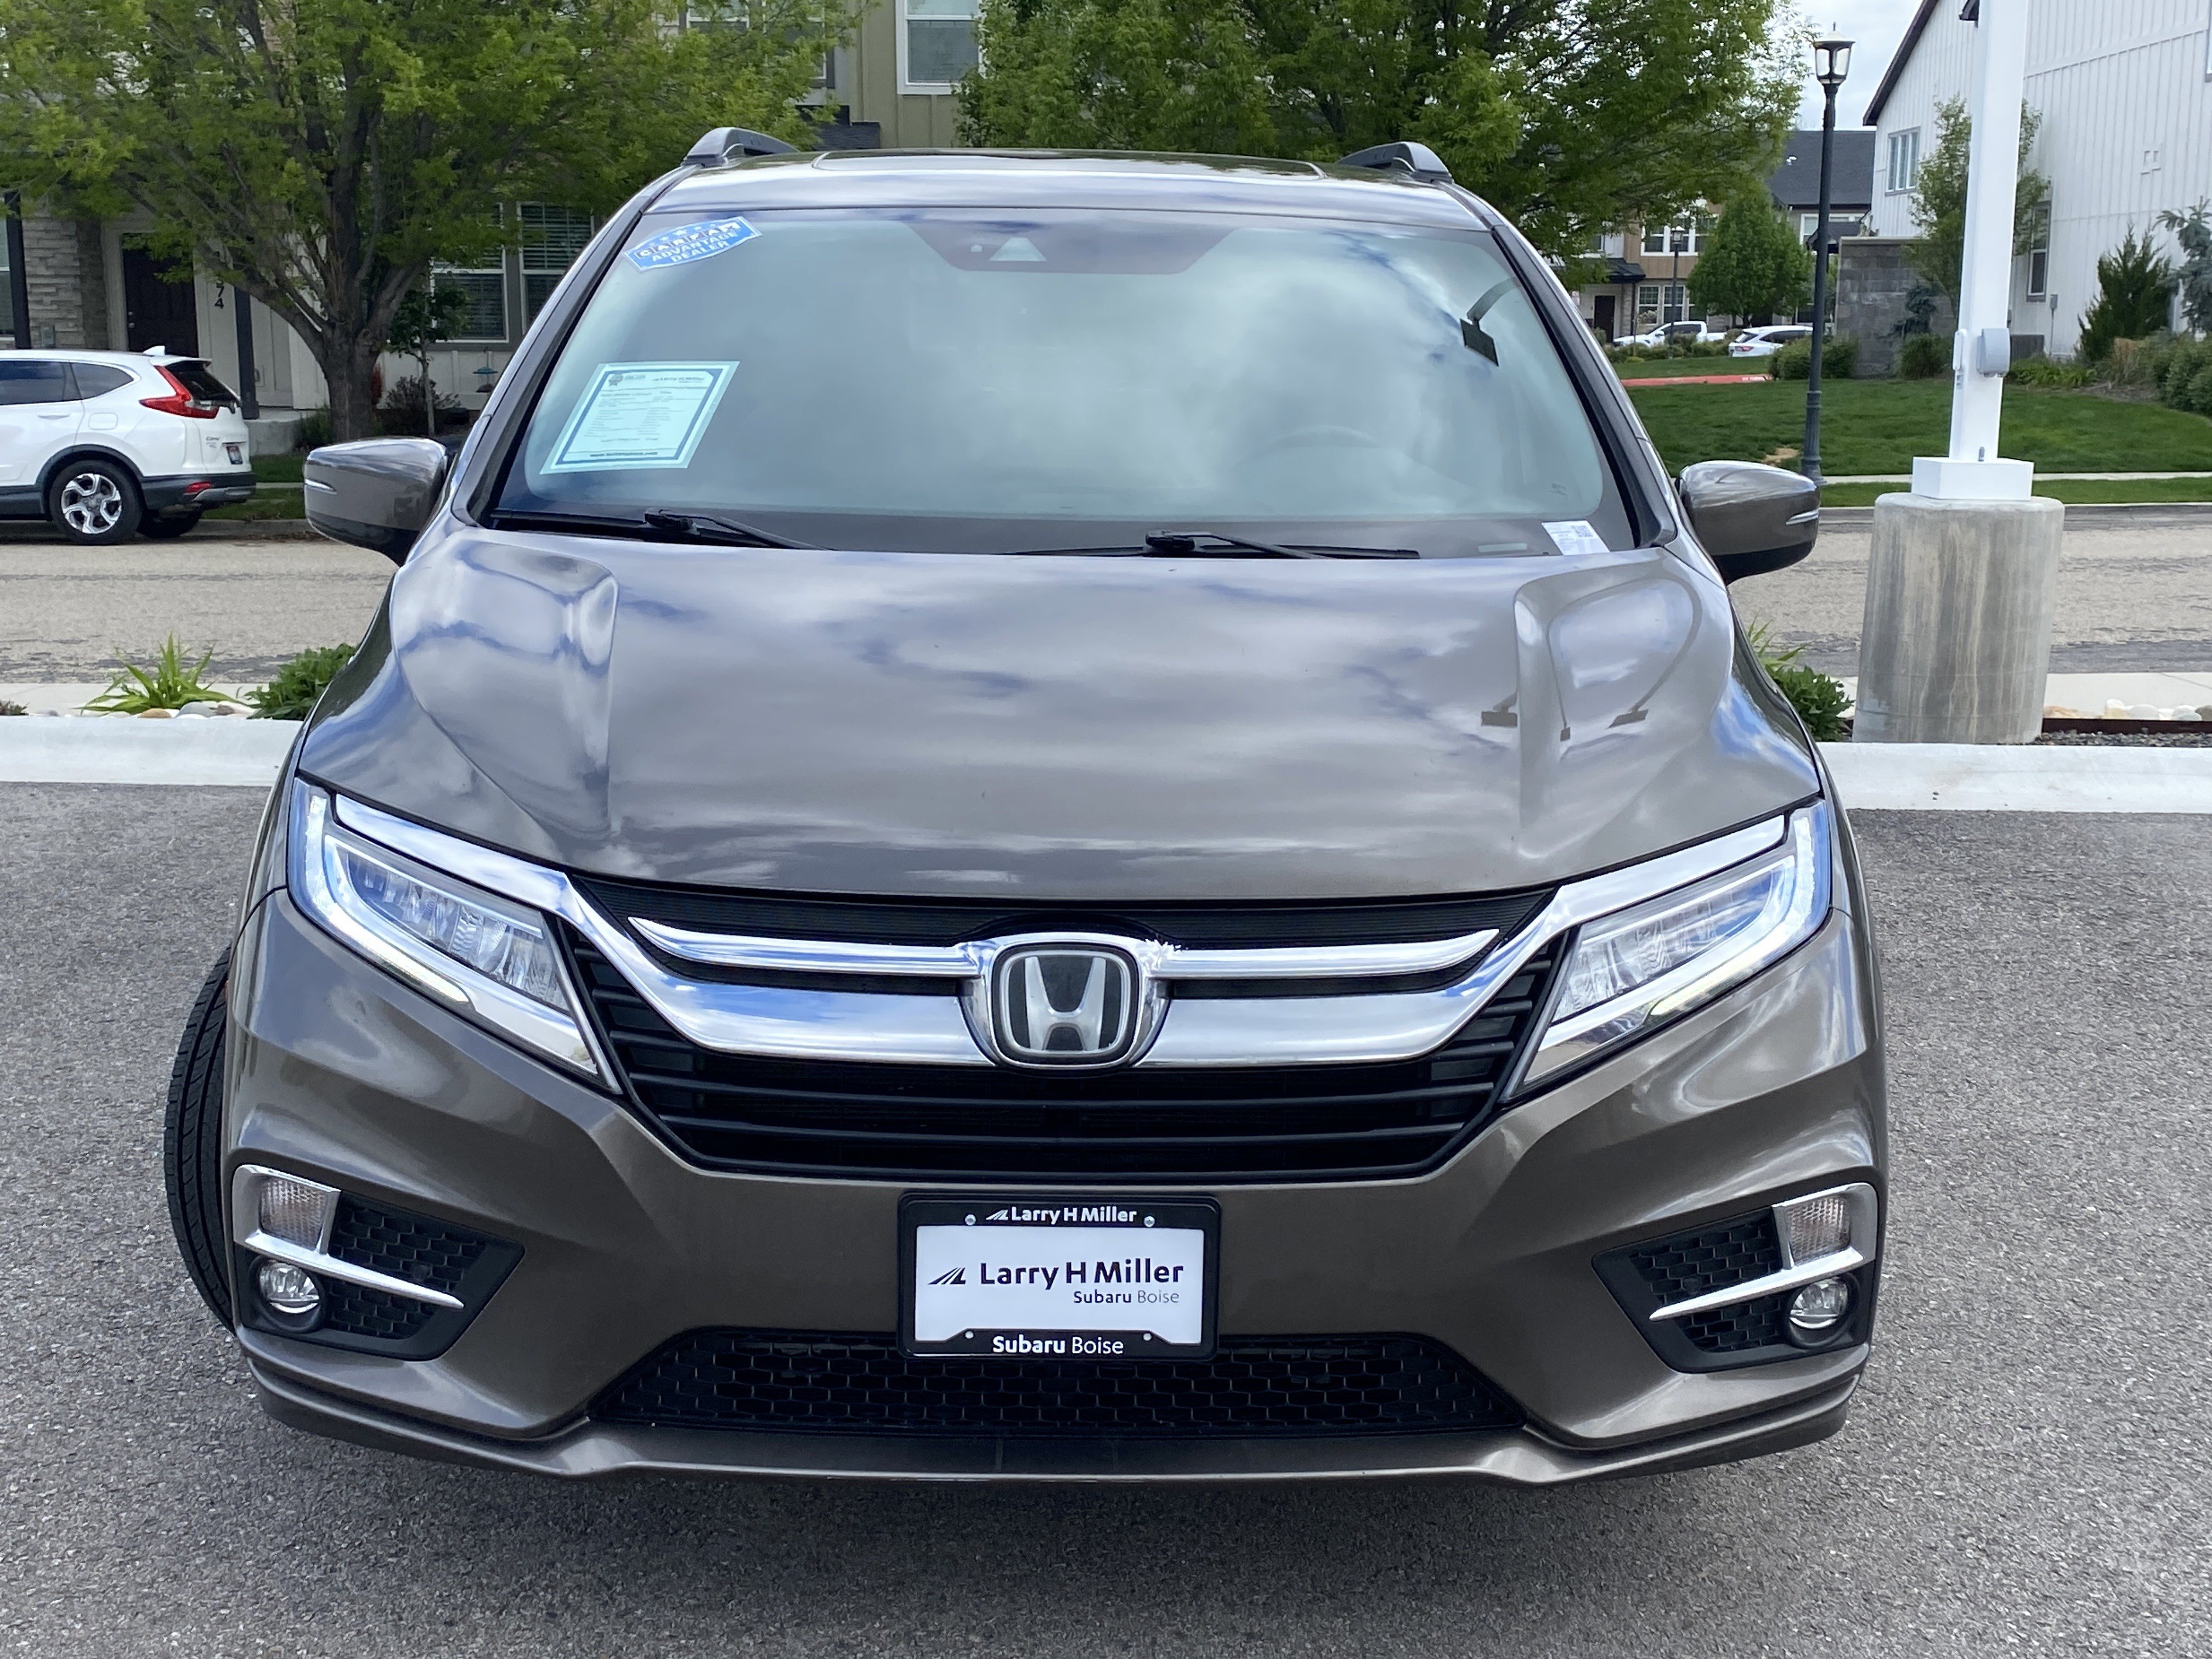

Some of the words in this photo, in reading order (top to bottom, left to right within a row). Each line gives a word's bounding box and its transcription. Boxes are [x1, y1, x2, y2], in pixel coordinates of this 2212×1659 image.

[652, 230, 738, 261] ADVANTAGE
[670, 241, 729, 262] DEALER
[1011, 1206, 1060, 1224] Larry
[1063, 1207, 1078, 1222] H
[1081, 1206, 1137, 1222] Miller
[980, 1262, 1059, 1290] Larry
[1066, 1262, 1086, 1284] H
[1094, 1258, 1184, 1283] Miller
[1073, 1290, 1132, 1304] Subaru
[1137, 1290, 1180, 1304] Boise
[992, 1335, 1065, 1354] Subaru
[1071, 1336, 1124, 1355] Boise
